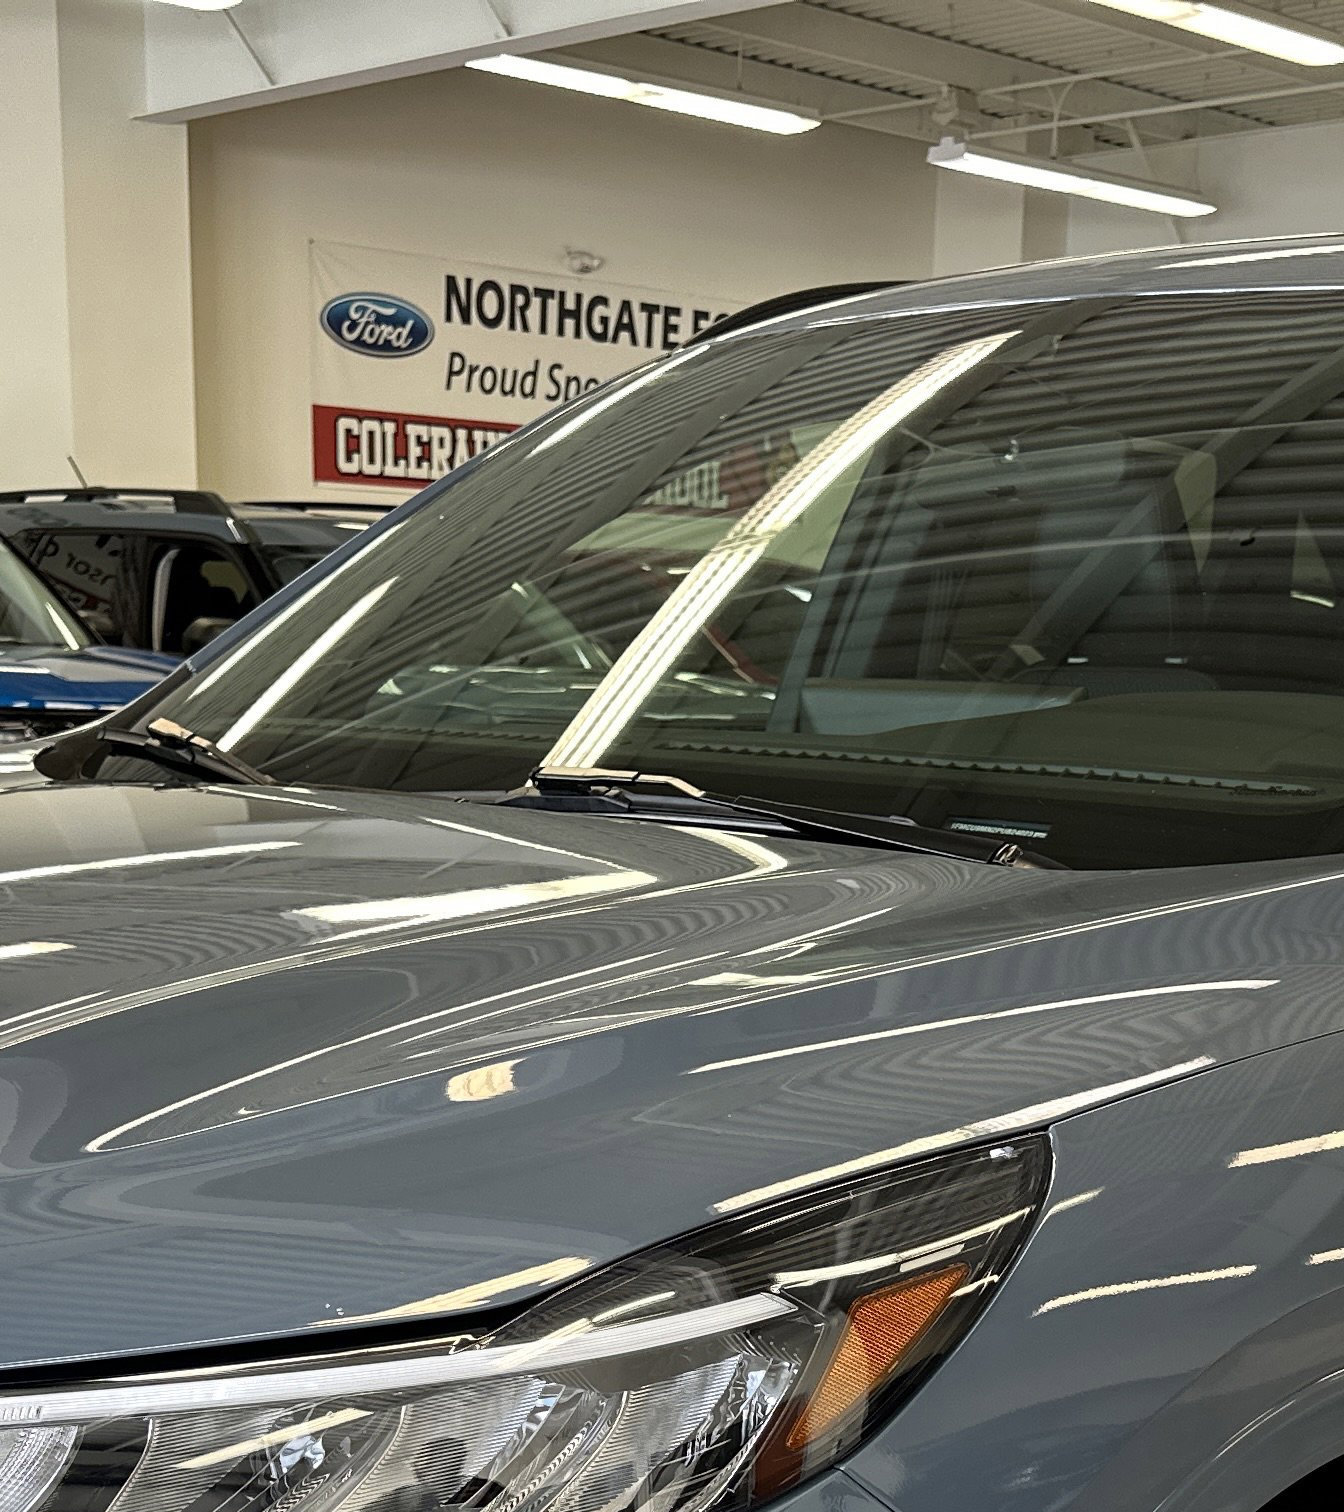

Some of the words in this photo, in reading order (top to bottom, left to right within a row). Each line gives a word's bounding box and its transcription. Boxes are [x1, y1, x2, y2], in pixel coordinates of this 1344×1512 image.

[340, 298, 415, 350] Ford
[444, 274, 680, 350] NORTHGATE
[446, 352, 541, 400] Proud
[336, 416, 509, 481] COLERA
